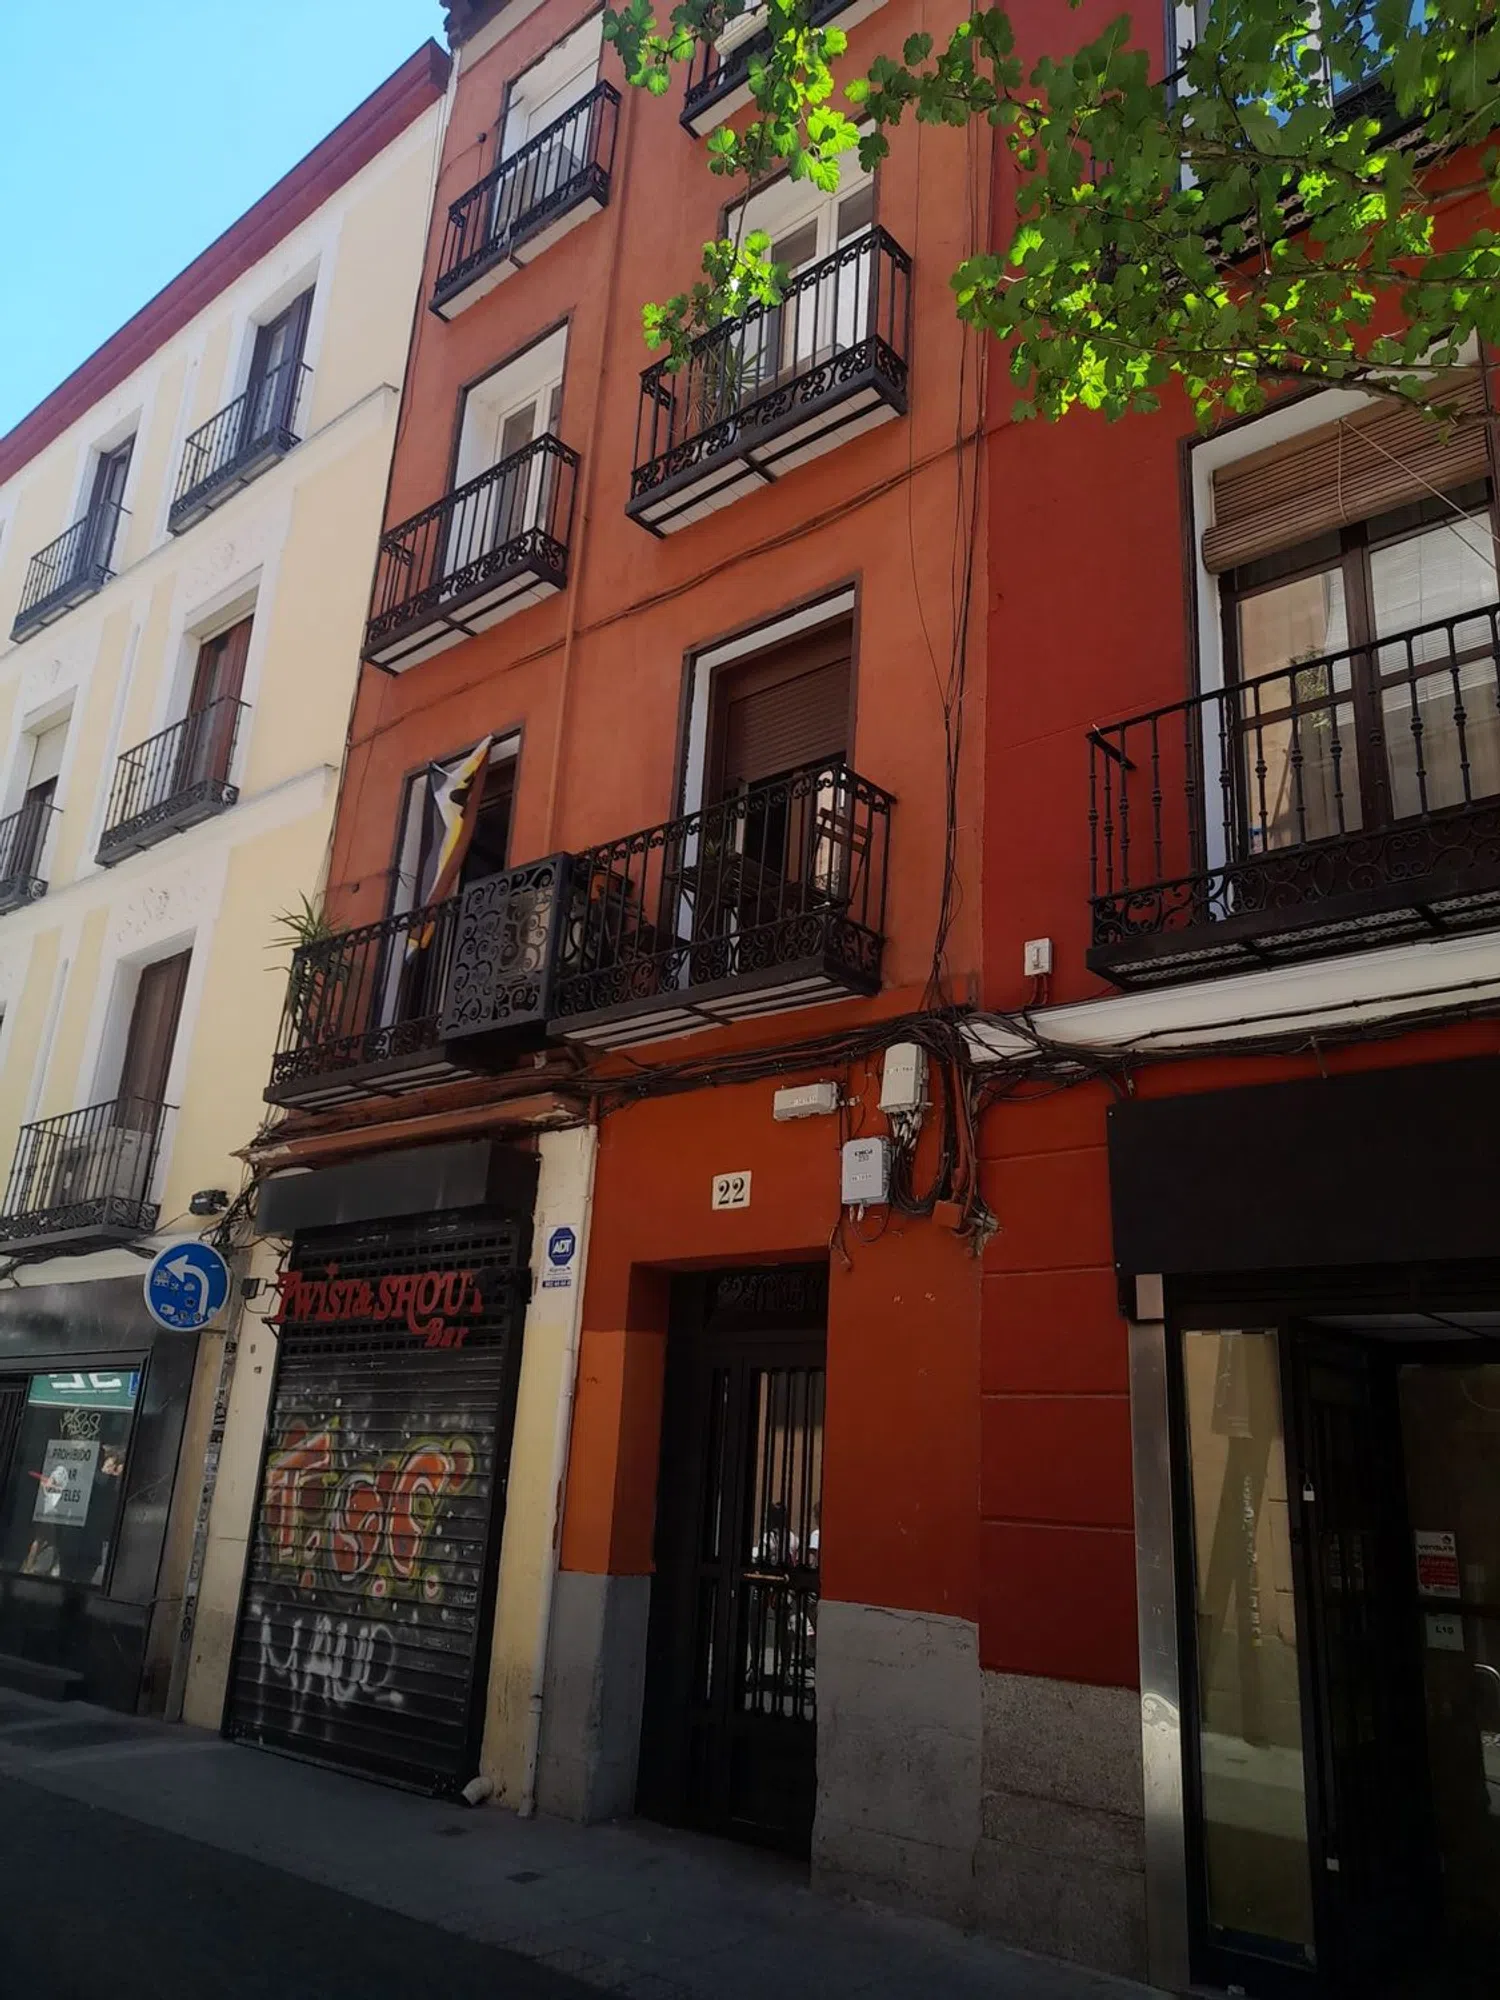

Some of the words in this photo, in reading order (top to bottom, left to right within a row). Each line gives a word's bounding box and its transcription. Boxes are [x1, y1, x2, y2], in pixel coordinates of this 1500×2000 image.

[717, 1176, 746, 1205] 22
[552, 1239, 572, 1254] ADT
[52, 1448, 92, 1462] PROHIBIDO
